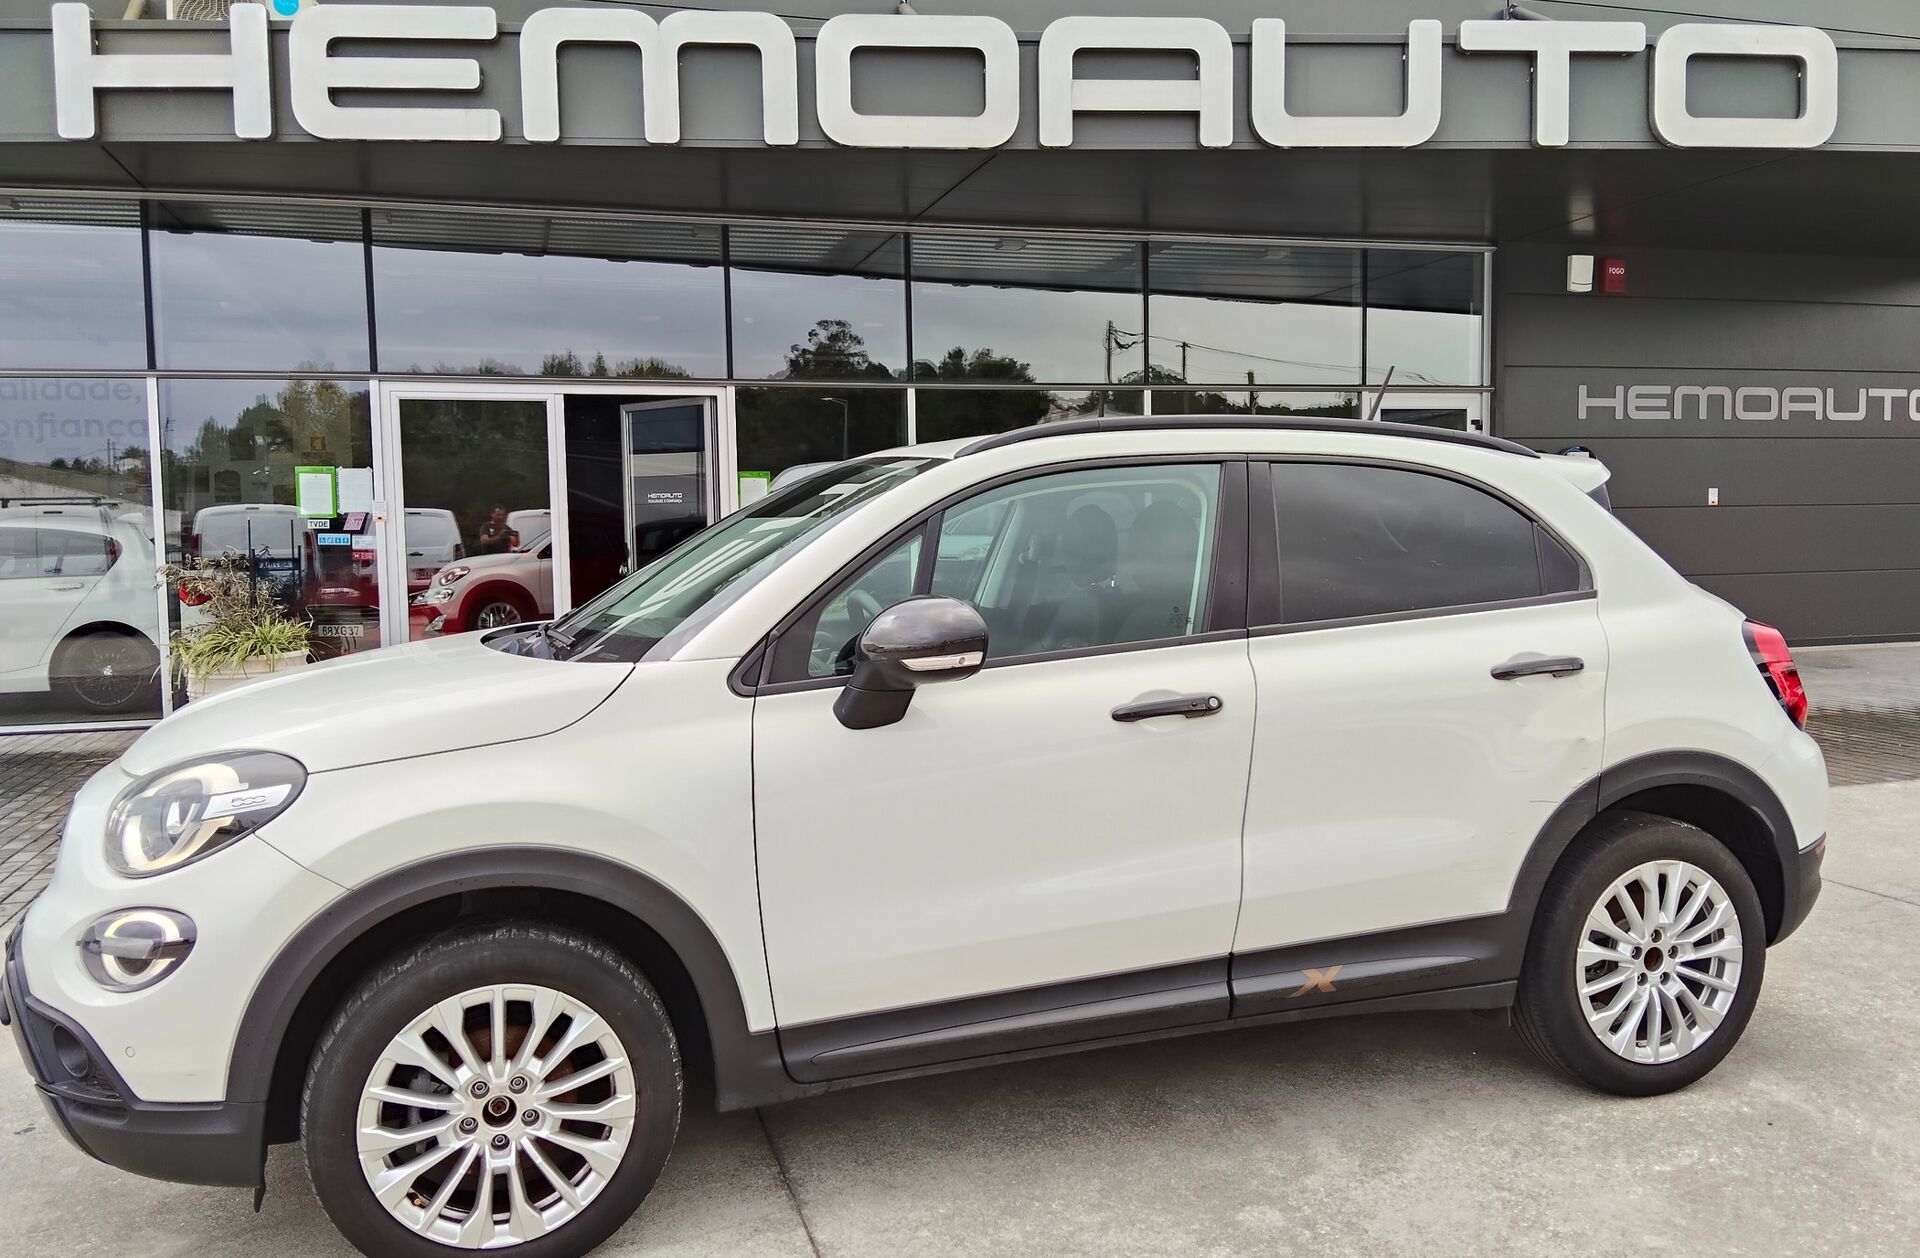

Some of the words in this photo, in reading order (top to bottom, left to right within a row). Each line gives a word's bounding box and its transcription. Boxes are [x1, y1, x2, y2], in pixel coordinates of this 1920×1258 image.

[52, 2, 1838, 150] HEMOAUTO
[1608, 267, 1625, 275] FOGO
[1578, 384, 1920, 421] HEMOAUT
[309, 520, 329, 528] TVDE
[231, 795, 266, 808] 500
